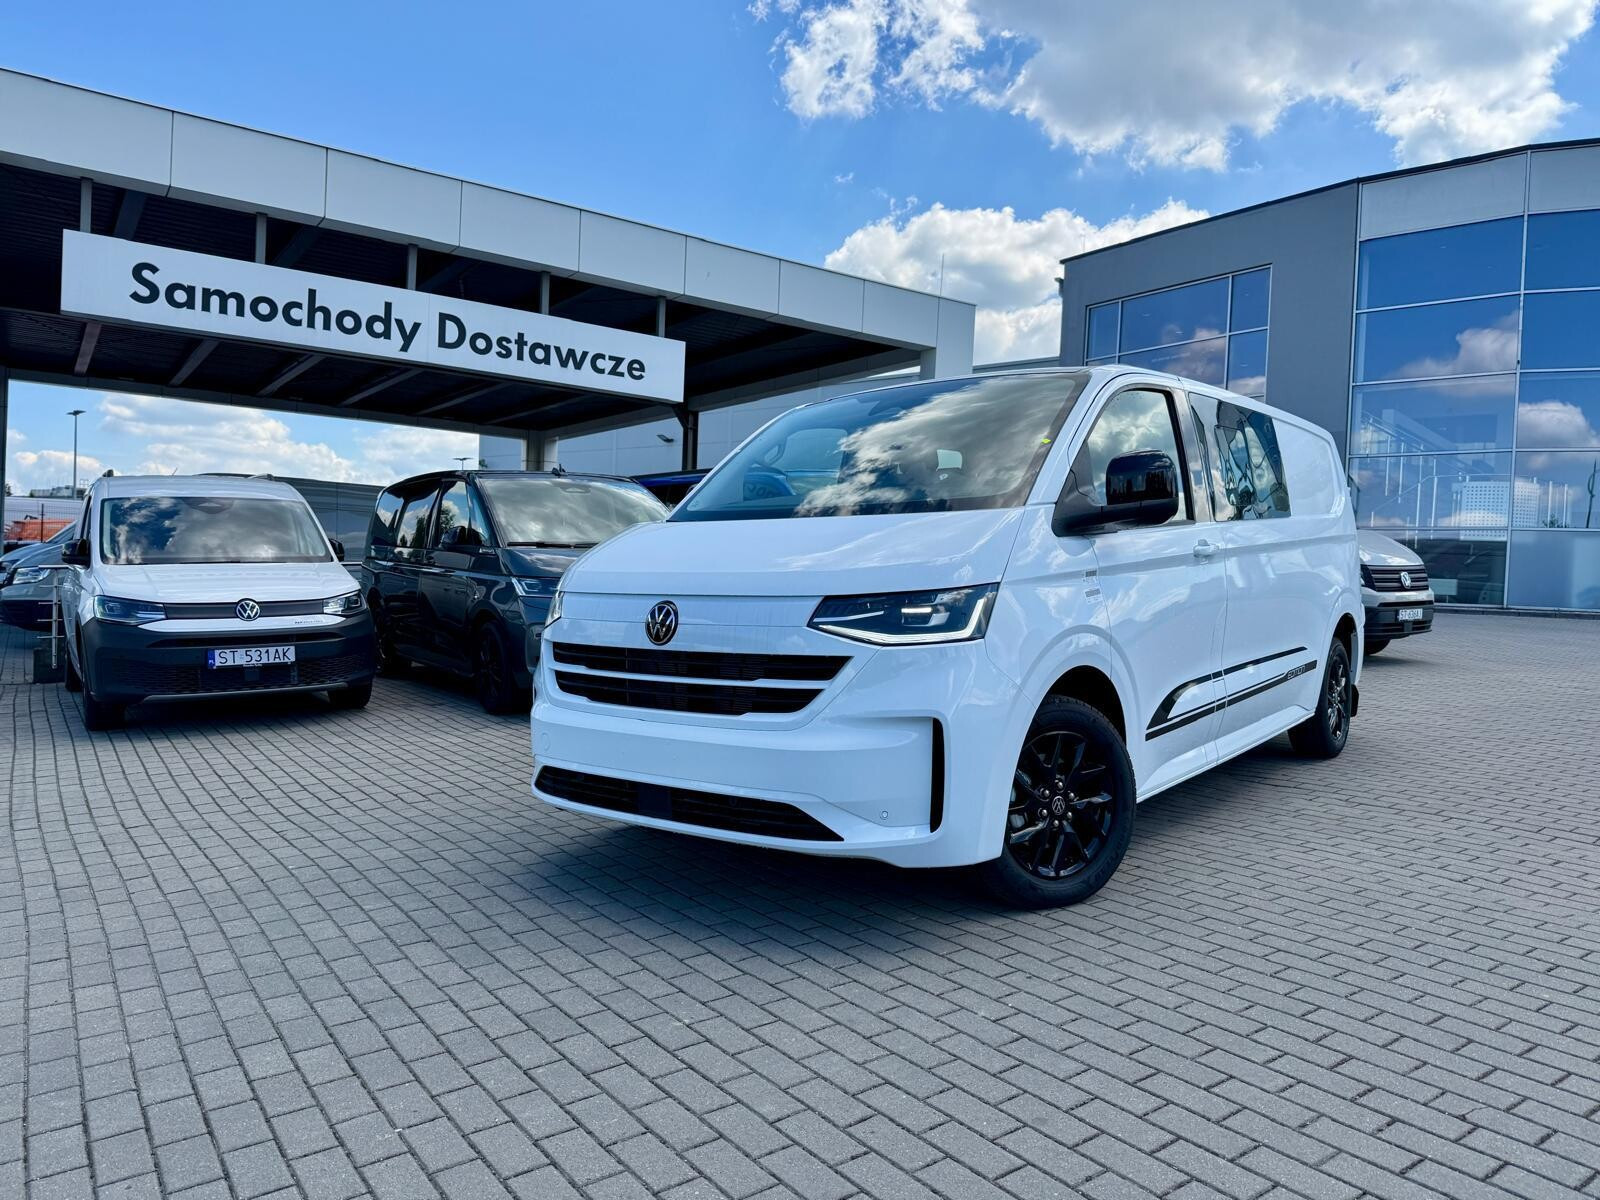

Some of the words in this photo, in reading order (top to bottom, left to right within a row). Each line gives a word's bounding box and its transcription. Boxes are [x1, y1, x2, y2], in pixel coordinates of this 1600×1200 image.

[129, 261, 422, 353] Samochody
[437, 311, 646, 381] Dostawcze
[218, 650, 239, 665] ST
[244, 647, 292, 663] 531AK
